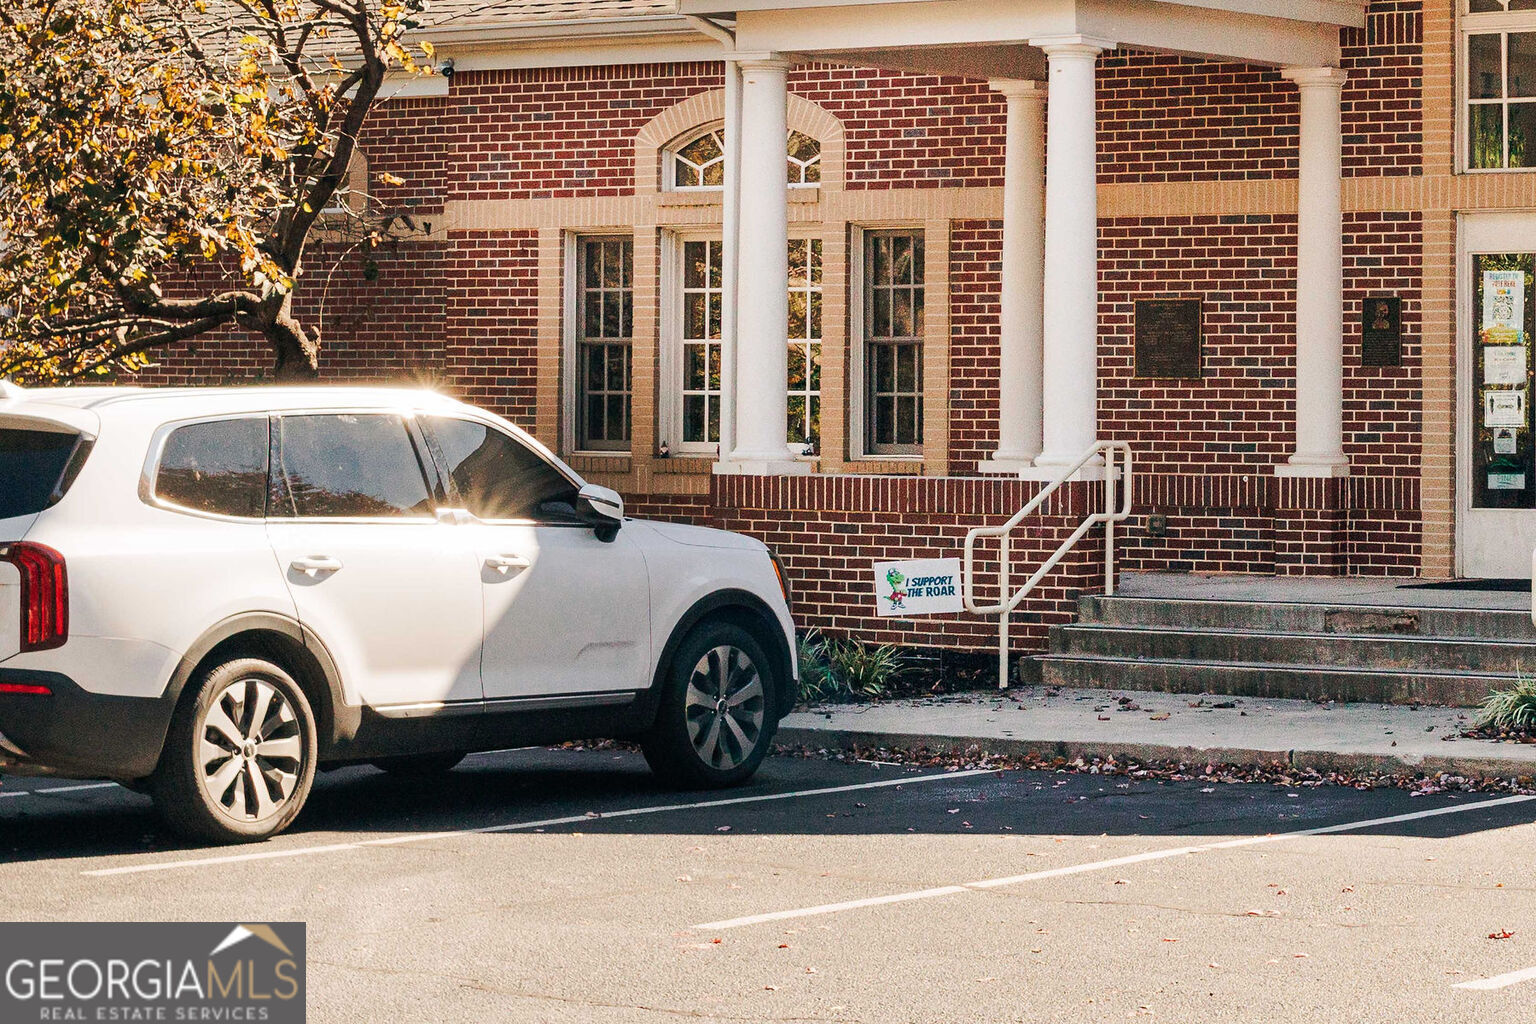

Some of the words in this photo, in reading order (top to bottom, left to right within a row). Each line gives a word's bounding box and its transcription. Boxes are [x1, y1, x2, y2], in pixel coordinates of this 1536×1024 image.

[905, 577, 910, 587] I
[911, 576, 953, 587] SUPPORT
[907, 587, 923, 598] THE
[926, 585, 956, 597] ROAR
